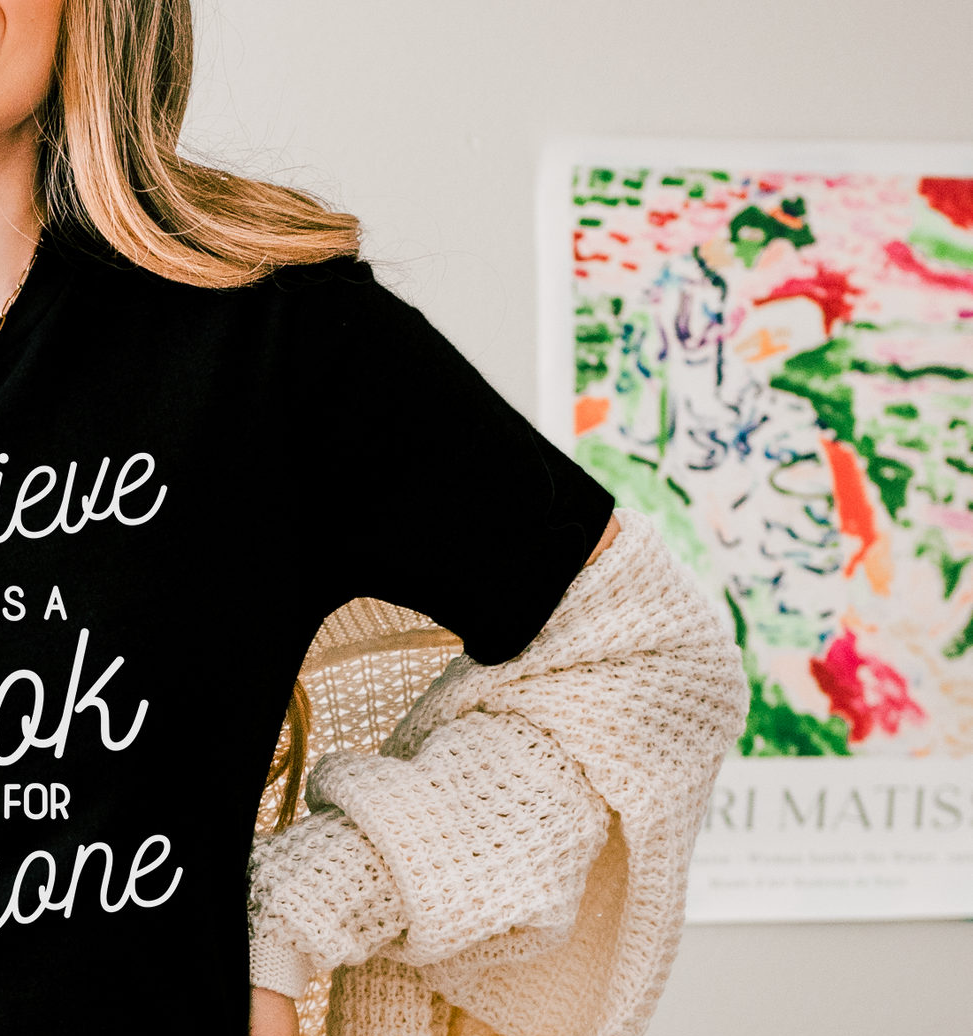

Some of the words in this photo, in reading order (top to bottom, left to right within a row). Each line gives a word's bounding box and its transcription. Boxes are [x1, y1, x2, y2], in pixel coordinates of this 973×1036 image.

[43, 585, 68, 621] A
[3, 782, 71, 820] FOR
[778, 781, 973, 834] MATIS
